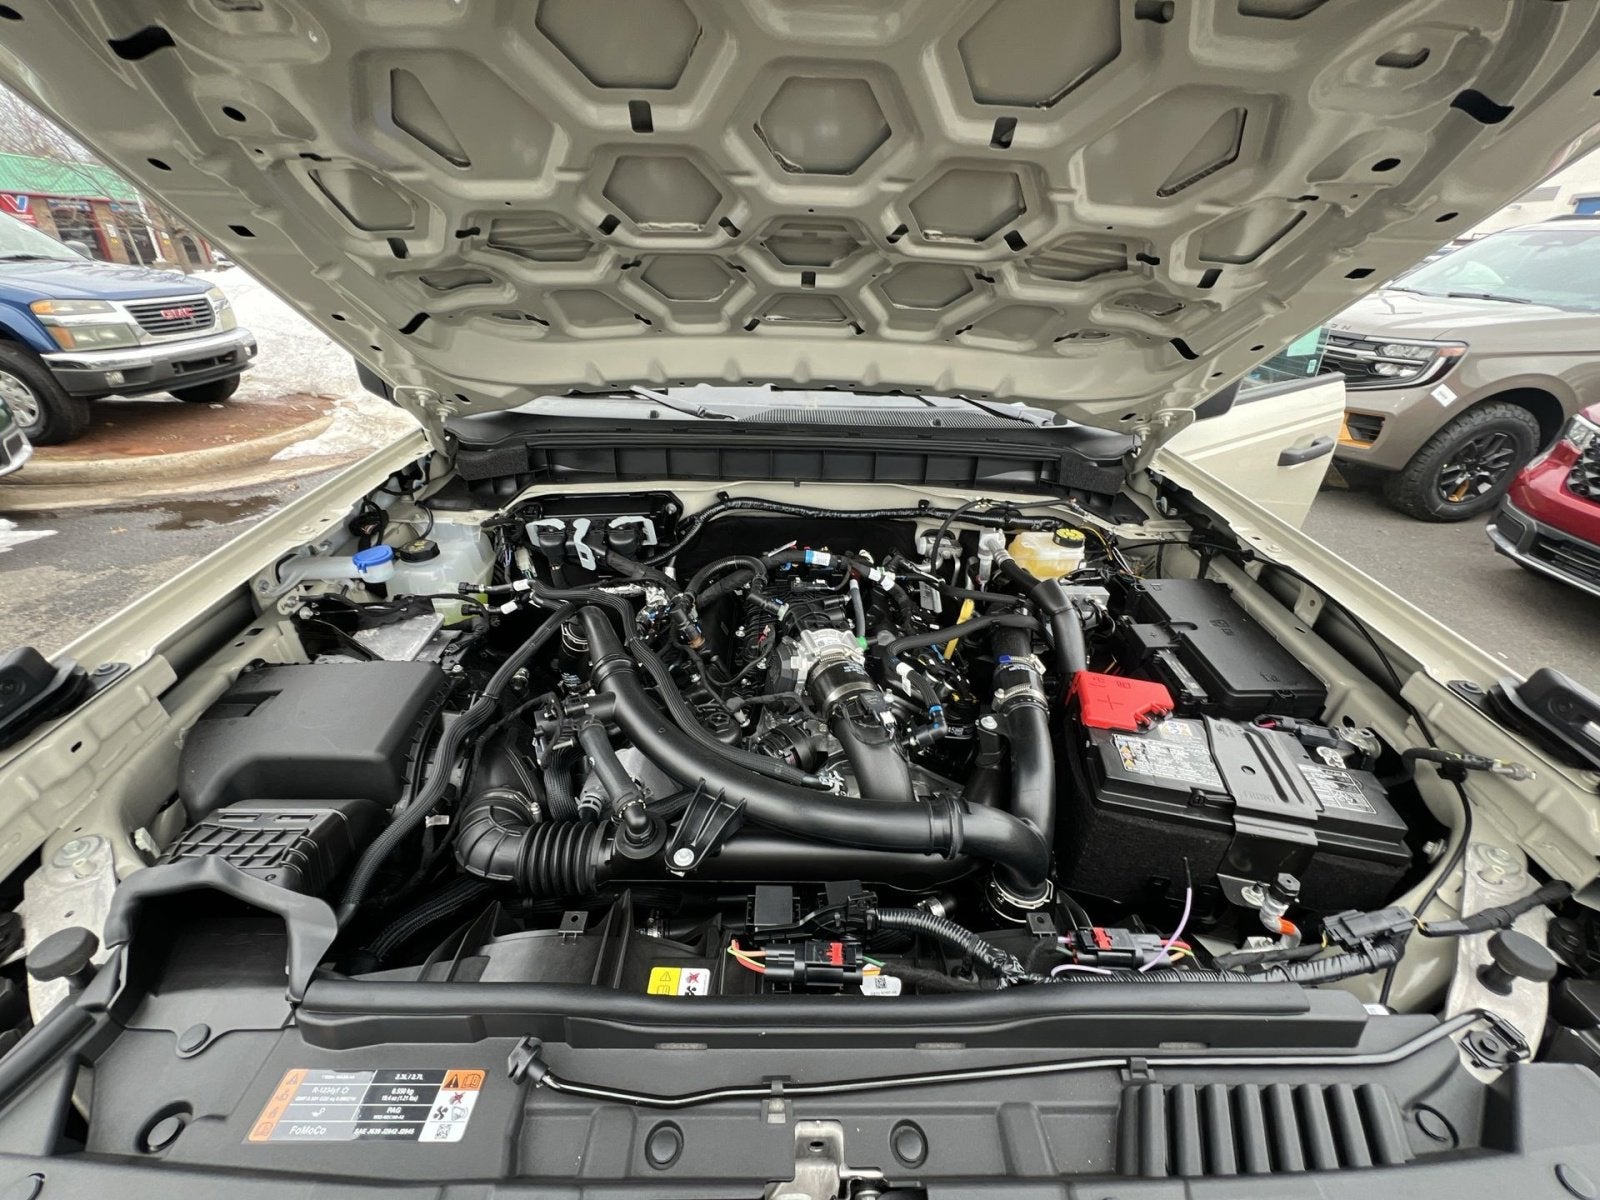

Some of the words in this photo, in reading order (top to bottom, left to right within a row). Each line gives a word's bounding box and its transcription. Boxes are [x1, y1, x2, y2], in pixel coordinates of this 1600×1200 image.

[160, 307, 193, 320] GMC
[386, 1106, 402, 1114] PAG
[289, 1125, 327, 1135] FoMoCo
